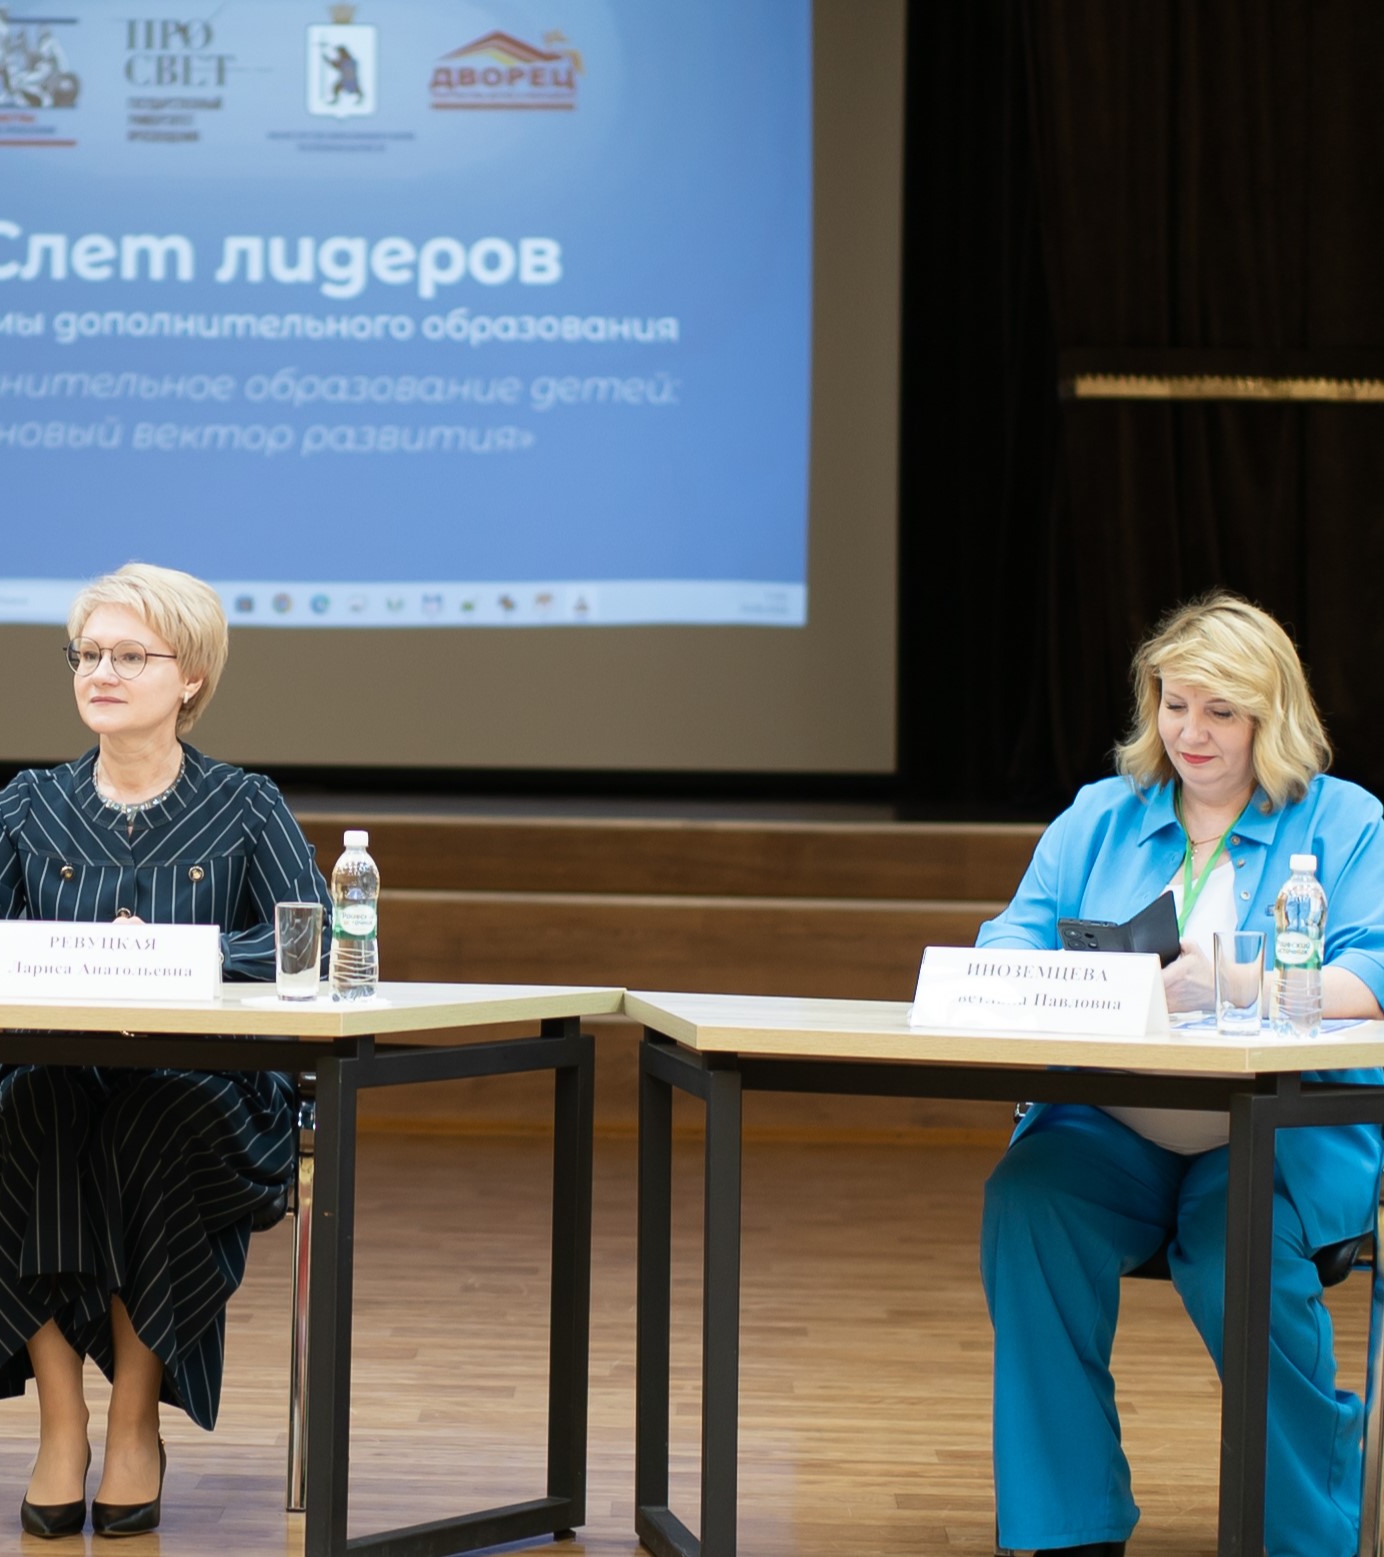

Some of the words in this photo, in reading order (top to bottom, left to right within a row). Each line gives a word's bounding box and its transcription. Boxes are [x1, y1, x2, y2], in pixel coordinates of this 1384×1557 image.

[124, 18, 215, 50] ПРО
[123, 53, 238, 88] СВЕТ
[430, 66, 577, 90] ДВОРЕЦ
[215, 232, 563, 299] лидеров
[53, 308, 414, 344] дополнительного
[421, 308, 680, 347] образования
[243, 367, 523, 406] образование
[131, 423, 295, 455] вектор
[301, 425, 536, 455] развития»
[49, 936, 157, 951] РЕВУЦКАЯ
[8, 960, 72, 978] Лариса
[77, 963, 193, 978] Анатольевна
[966, 962, 1109, 982] ИНОЗЕМЦЕВА
[1033, 993, 1122, 1010] Павловна
